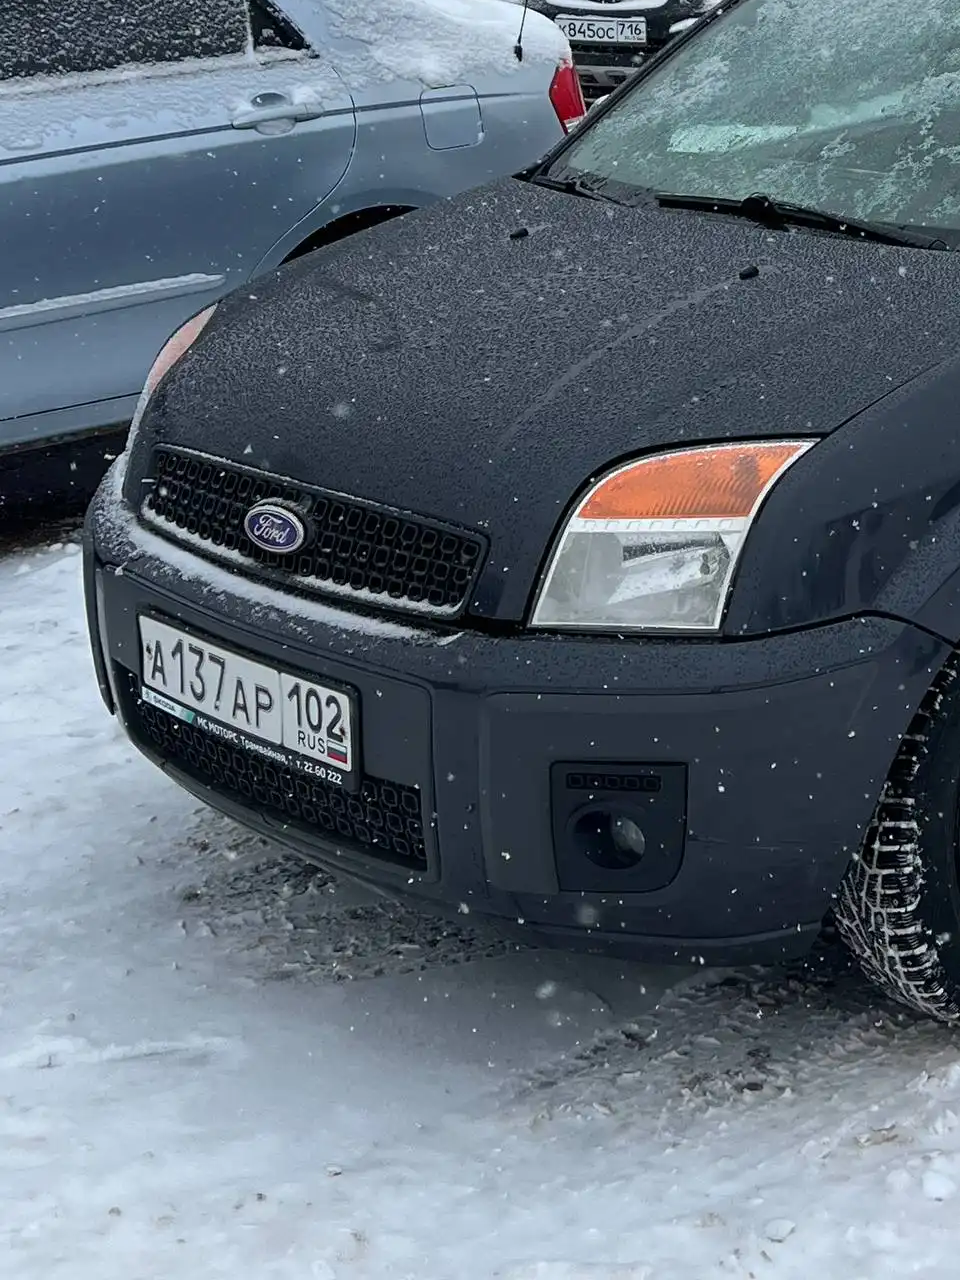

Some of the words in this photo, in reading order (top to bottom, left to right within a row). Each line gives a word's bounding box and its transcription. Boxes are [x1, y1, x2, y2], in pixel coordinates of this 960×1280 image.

[618, 23, 642, 36] 716
[253, 514, 291, 544] Ford
[287, 682, 345, 743] 102
[297, 729, 326, 754] RUS
